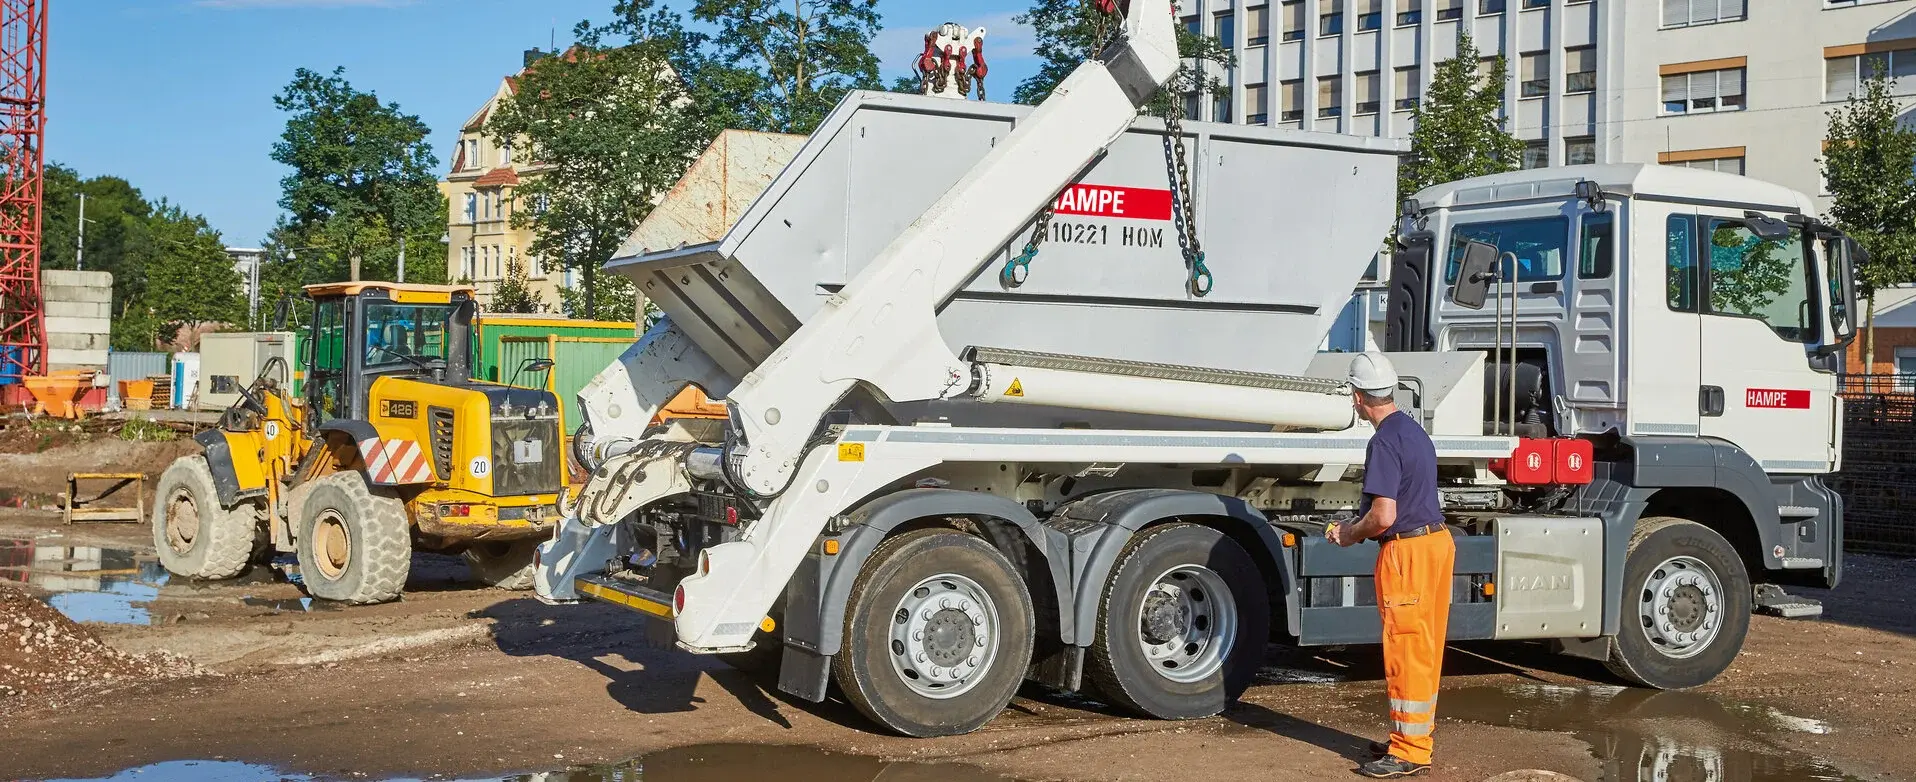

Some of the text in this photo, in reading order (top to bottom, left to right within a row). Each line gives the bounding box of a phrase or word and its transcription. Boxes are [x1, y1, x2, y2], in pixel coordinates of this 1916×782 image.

[1054, 188, 1125, 214] AMPE
[1747, 390, 1787, 407] HAMPE
[390, 403, 412, 415] 426
[474, 461, 486, 473] 20
[1510, 575, 1571, 591] MAN
